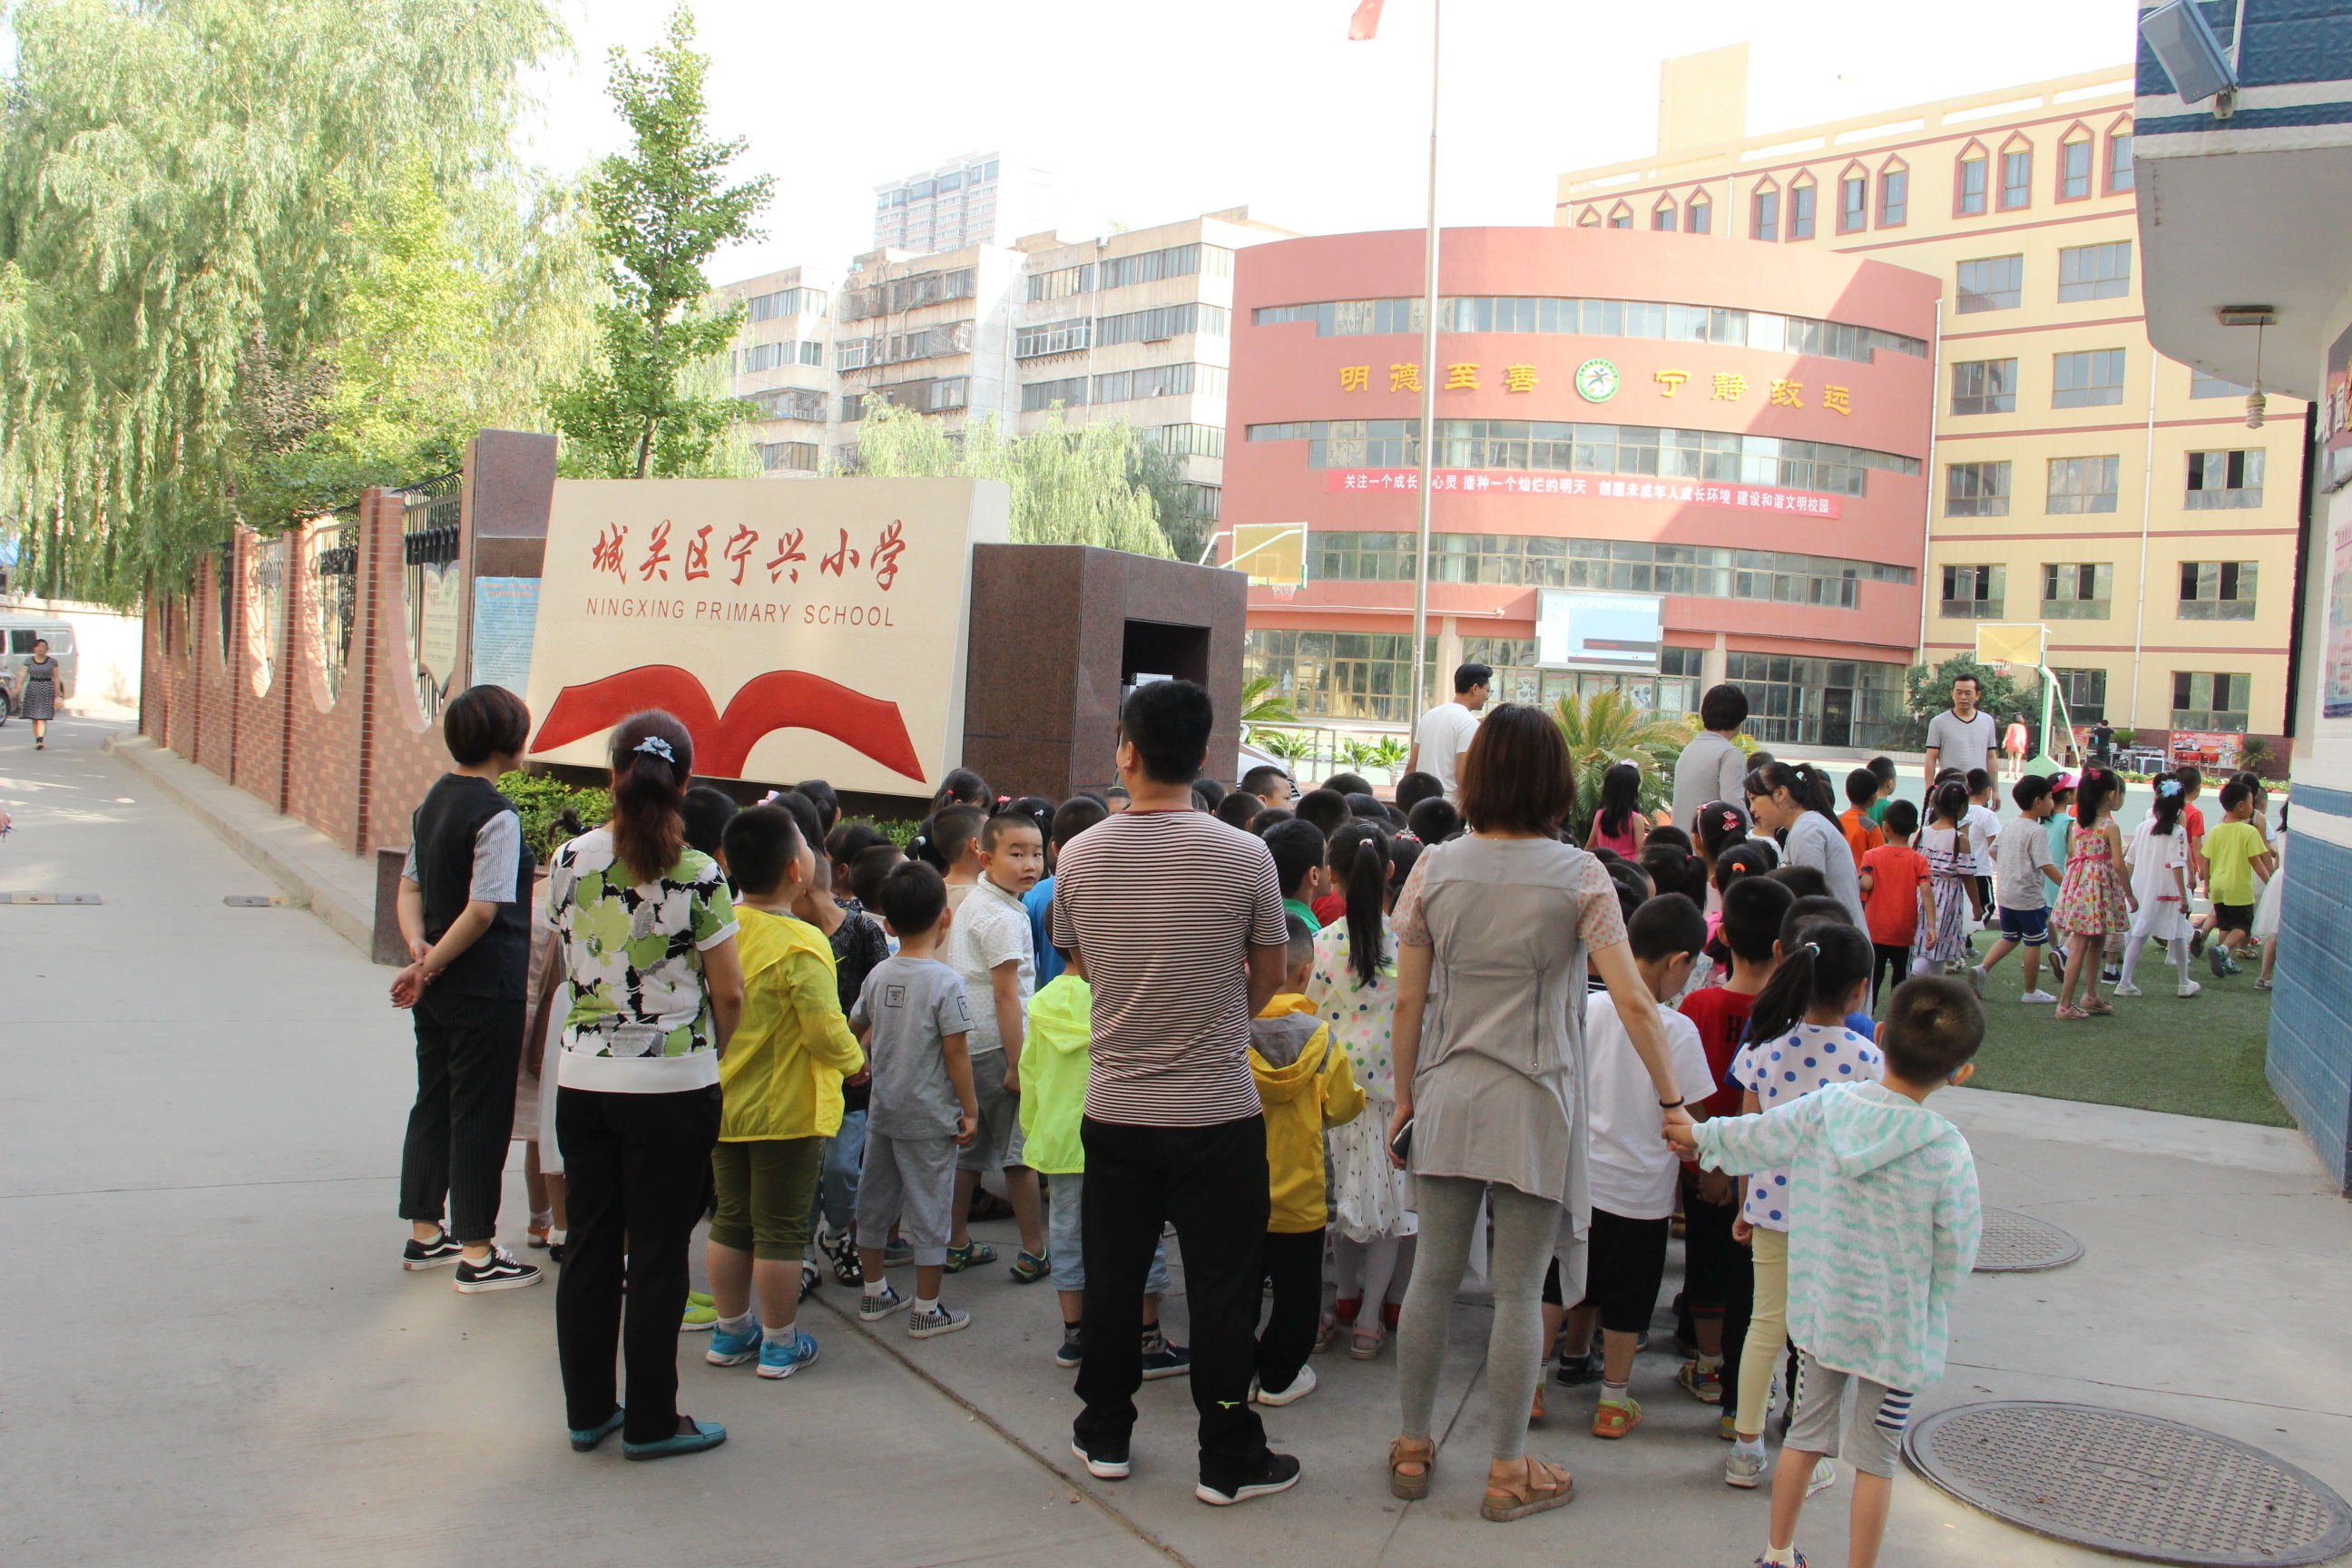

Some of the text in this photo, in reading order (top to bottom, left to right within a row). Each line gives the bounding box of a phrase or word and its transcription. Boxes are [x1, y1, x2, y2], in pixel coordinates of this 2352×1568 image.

[1339, 362, 1852, 416] 明德至善 宁静致远
[1344, 473, 1829, 514] 关注一个成长心灵 播种一个灿烂的明天 创建未成年人成长环境 建设和谐文明校园
[592, 519, 906, 592] 城关区宁兴小学
[586, 597, 894, 627] NINGXING PRIMARY SCHOOL
